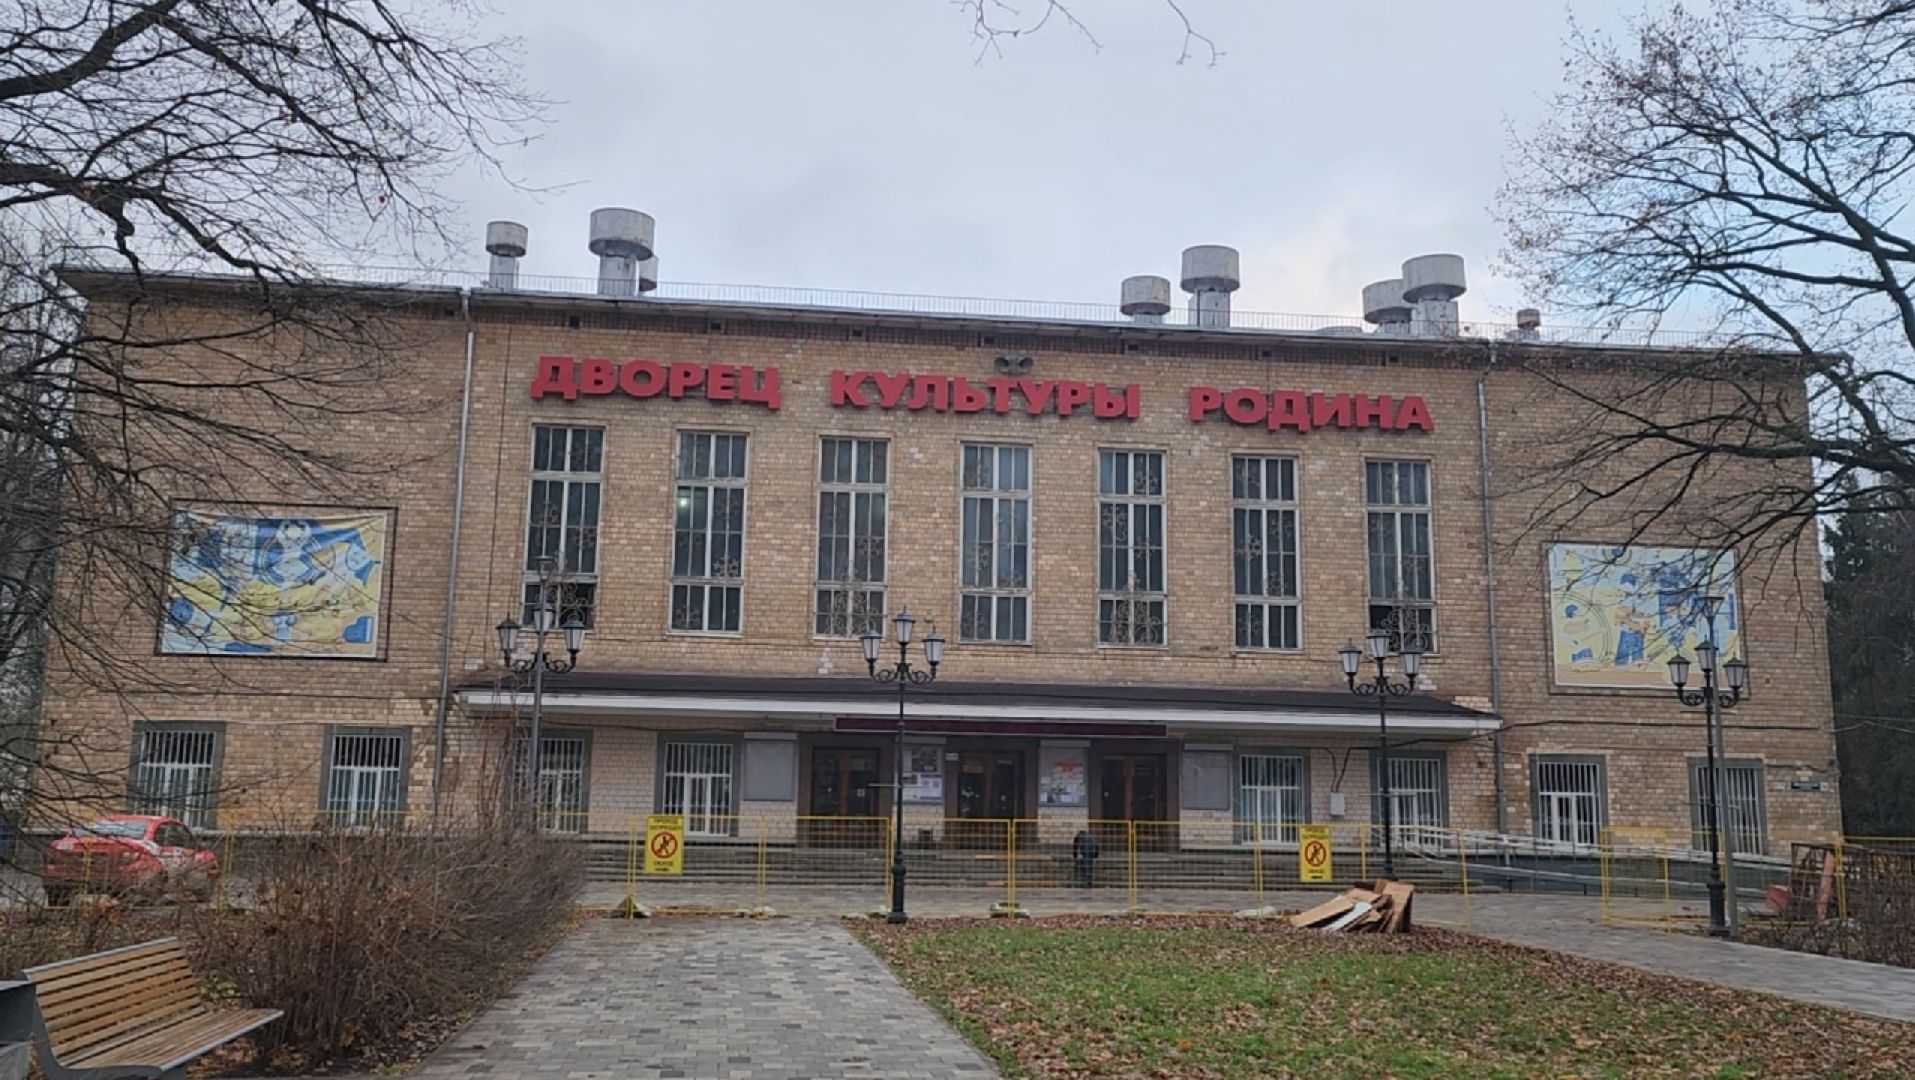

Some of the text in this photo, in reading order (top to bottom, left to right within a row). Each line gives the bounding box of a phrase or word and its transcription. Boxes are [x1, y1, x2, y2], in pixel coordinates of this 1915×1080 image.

[531, 356, 1434, 432] ДВОРЕЦ КУЛЬТУРЫ РОДИНА
